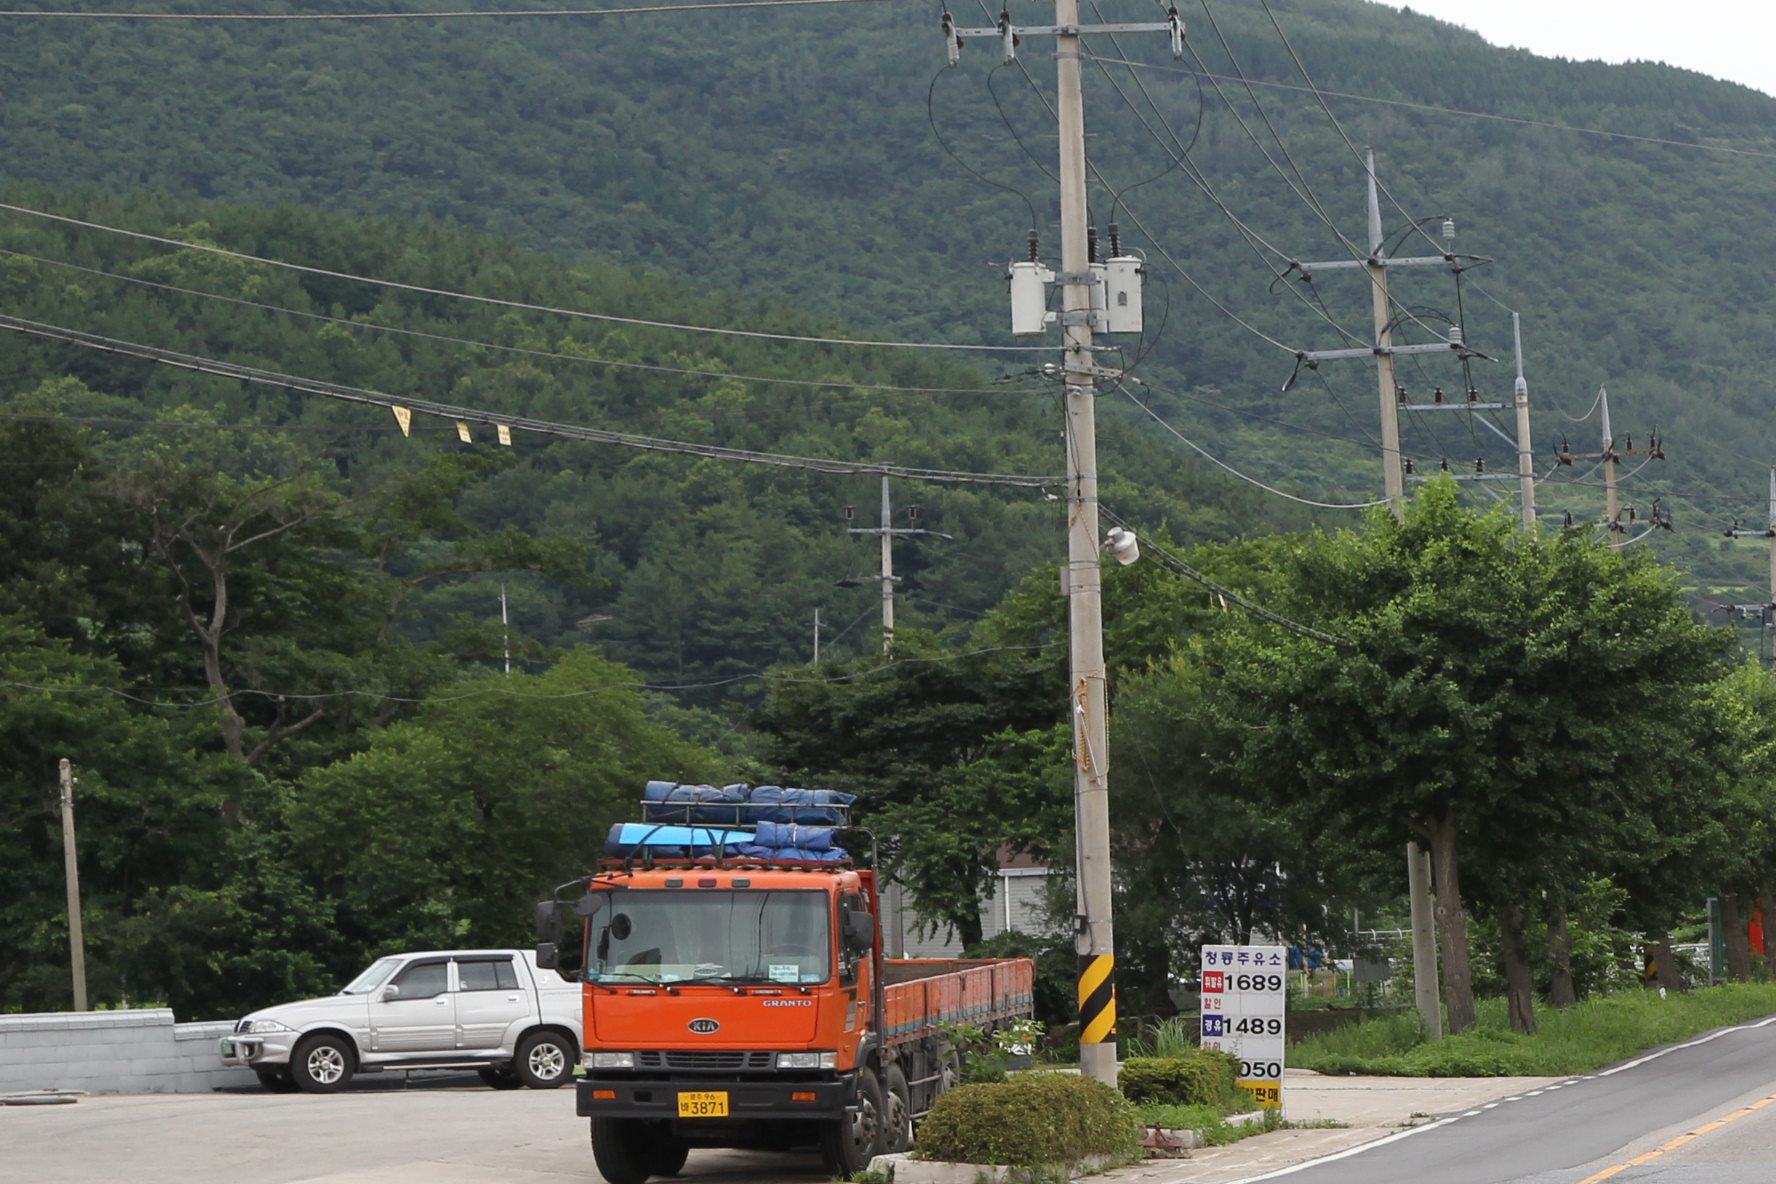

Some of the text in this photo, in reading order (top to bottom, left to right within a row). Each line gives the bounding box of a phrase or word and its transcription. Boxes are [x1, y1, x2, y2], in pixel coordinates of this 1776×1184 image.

[1225, 974, 1282, 991] 1689
[1204, 998, 1221, 1009] 할인
[692, 1021, 715, 1031] KIA
[1205, 1018, 1281, 1035] 경유 1489
[691, 1102, 724, 1114] 3871
